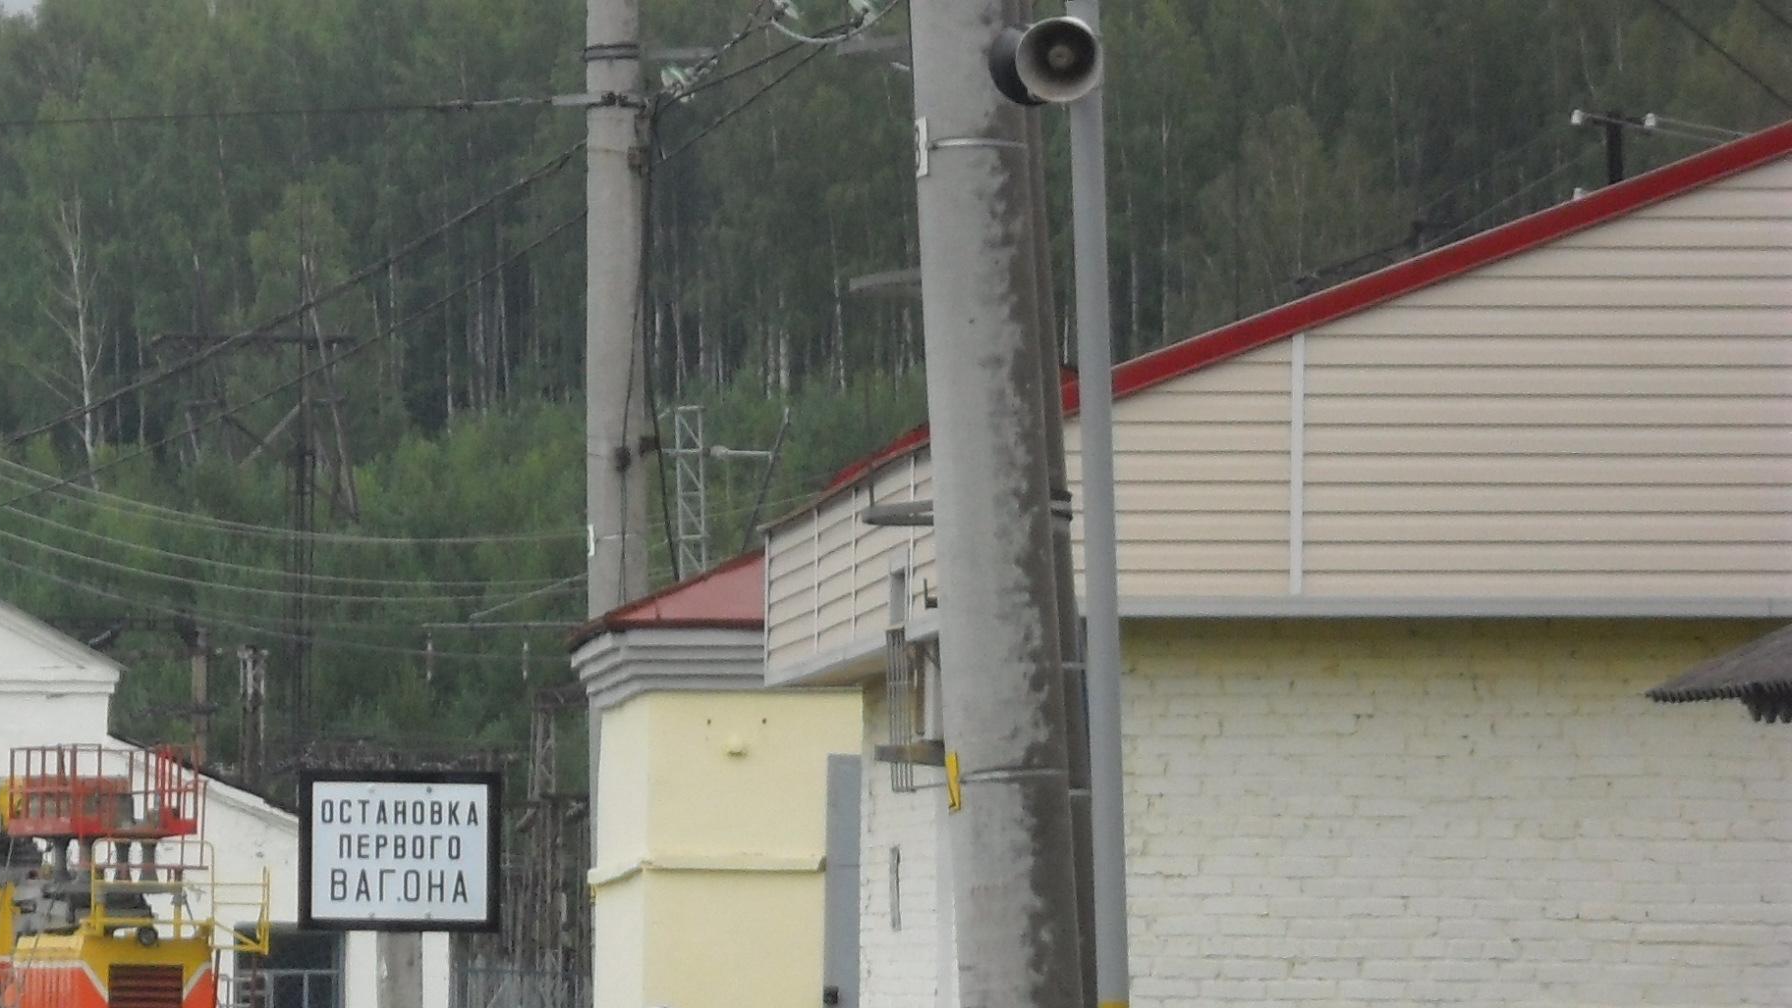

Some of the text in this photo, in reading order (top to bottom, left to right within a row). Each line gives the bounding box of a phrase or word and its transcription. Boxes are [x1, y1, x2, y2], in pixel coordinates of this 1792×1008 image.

[321, 799, 479, 826] ОСТАНОВКА
[339, 834, 461, 860] ПЕРВОГО
[330, 868, 469, 904] ВАГОНА
